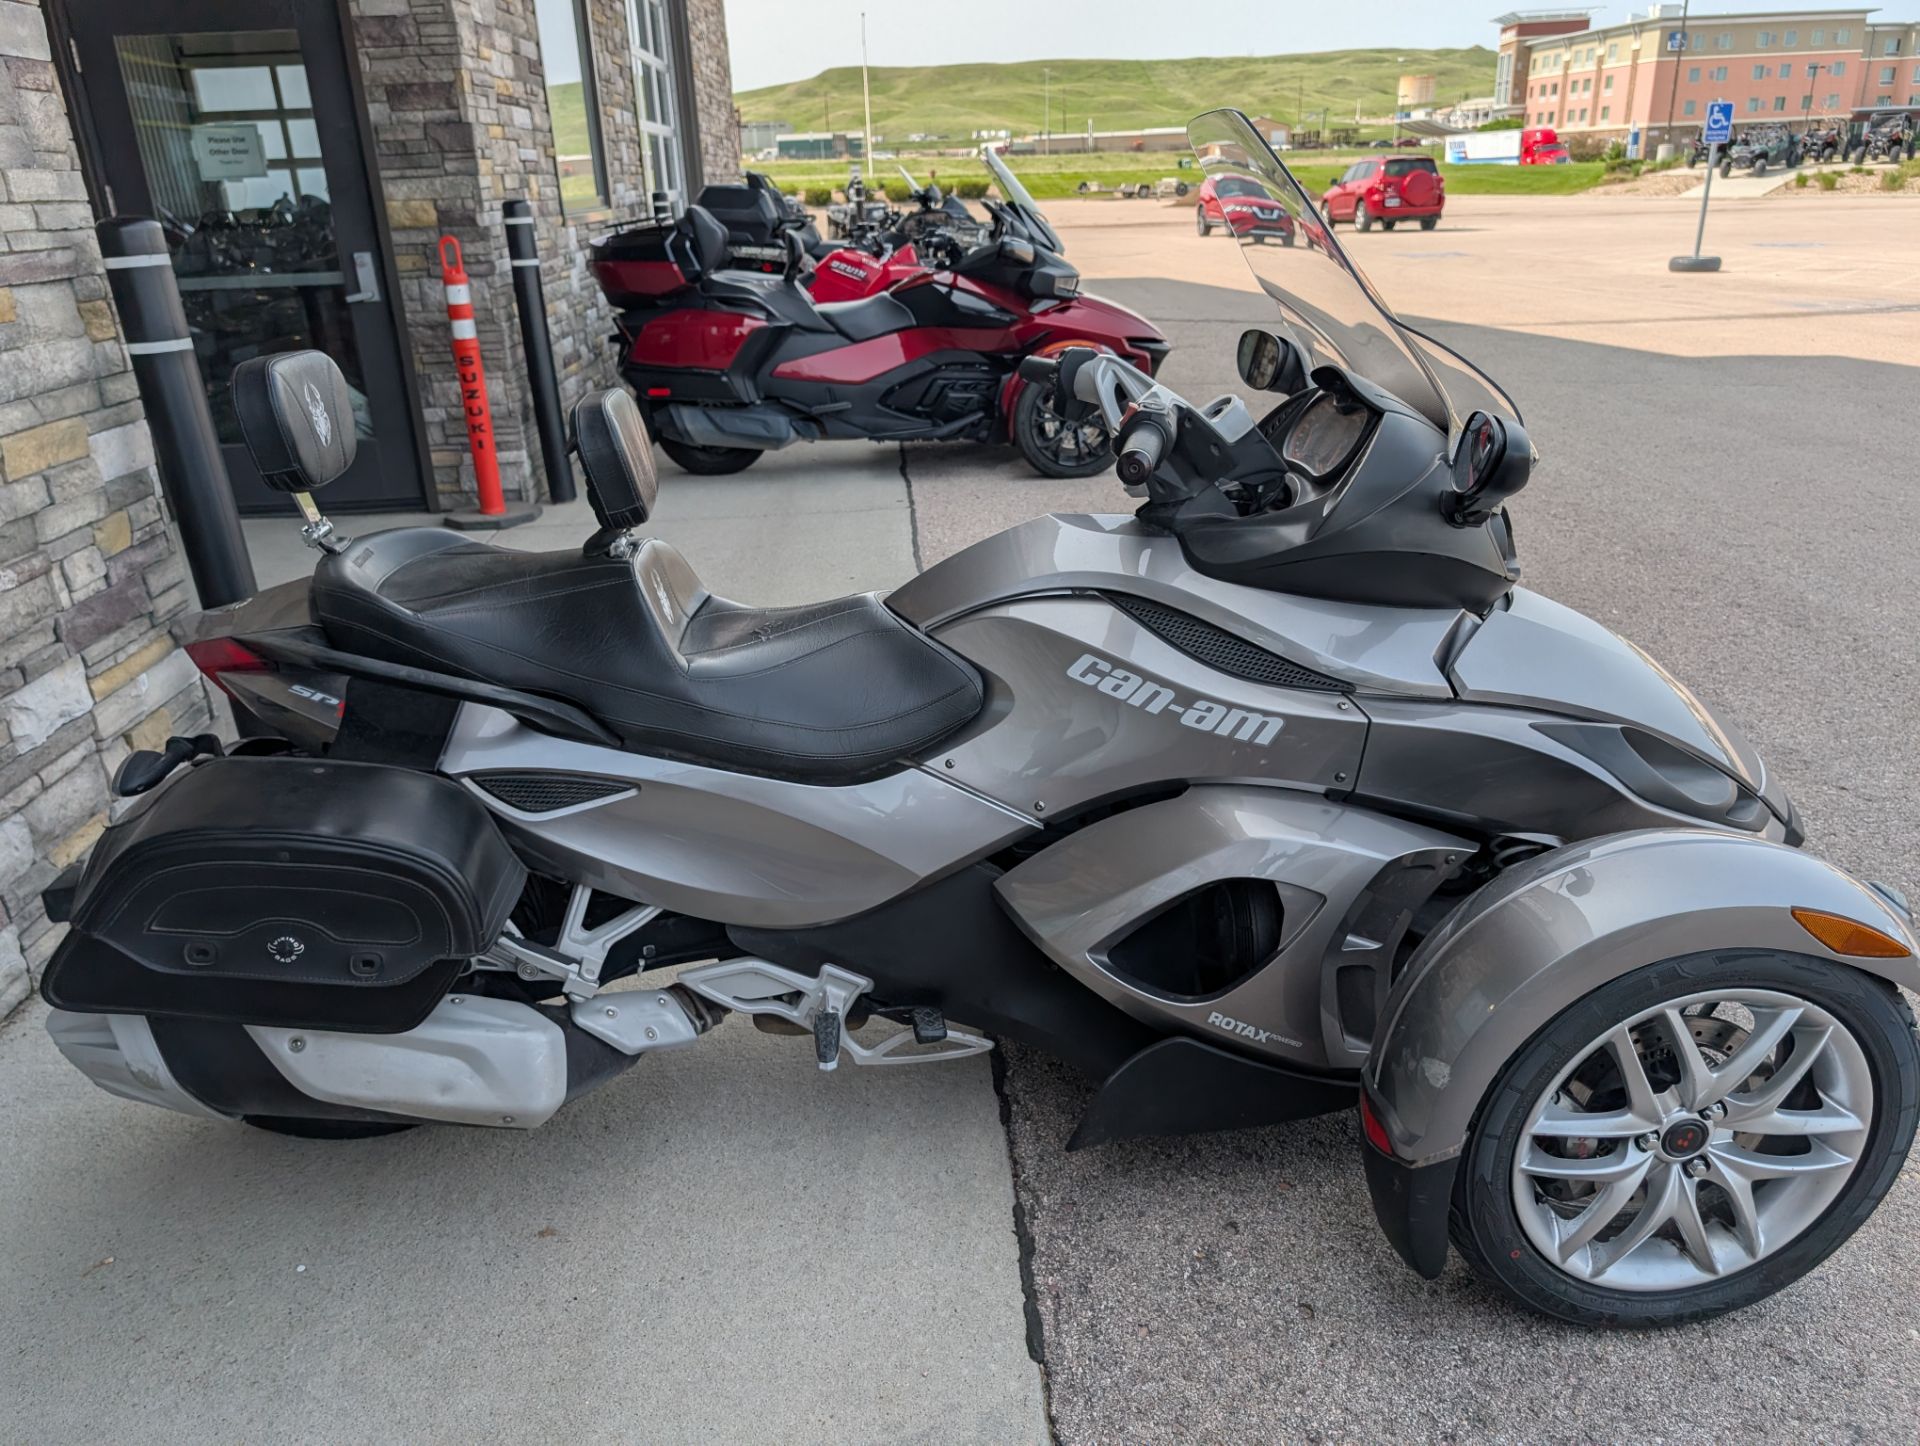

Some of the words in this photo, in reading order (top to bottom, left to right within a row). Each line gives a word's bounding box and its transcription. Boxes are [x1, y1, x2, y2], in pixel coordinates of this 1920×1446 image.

[831, 260, 867, 279] BRUIN
[460, 356, 486, 449] SUZUKI
[273, 936, 299, 948] VIKING
[274, 954, 297, 963] BAGS
[1207, 1011, 1271, 1043] ROTAX
[1269, 1033, 1303, 1048] POWERED
